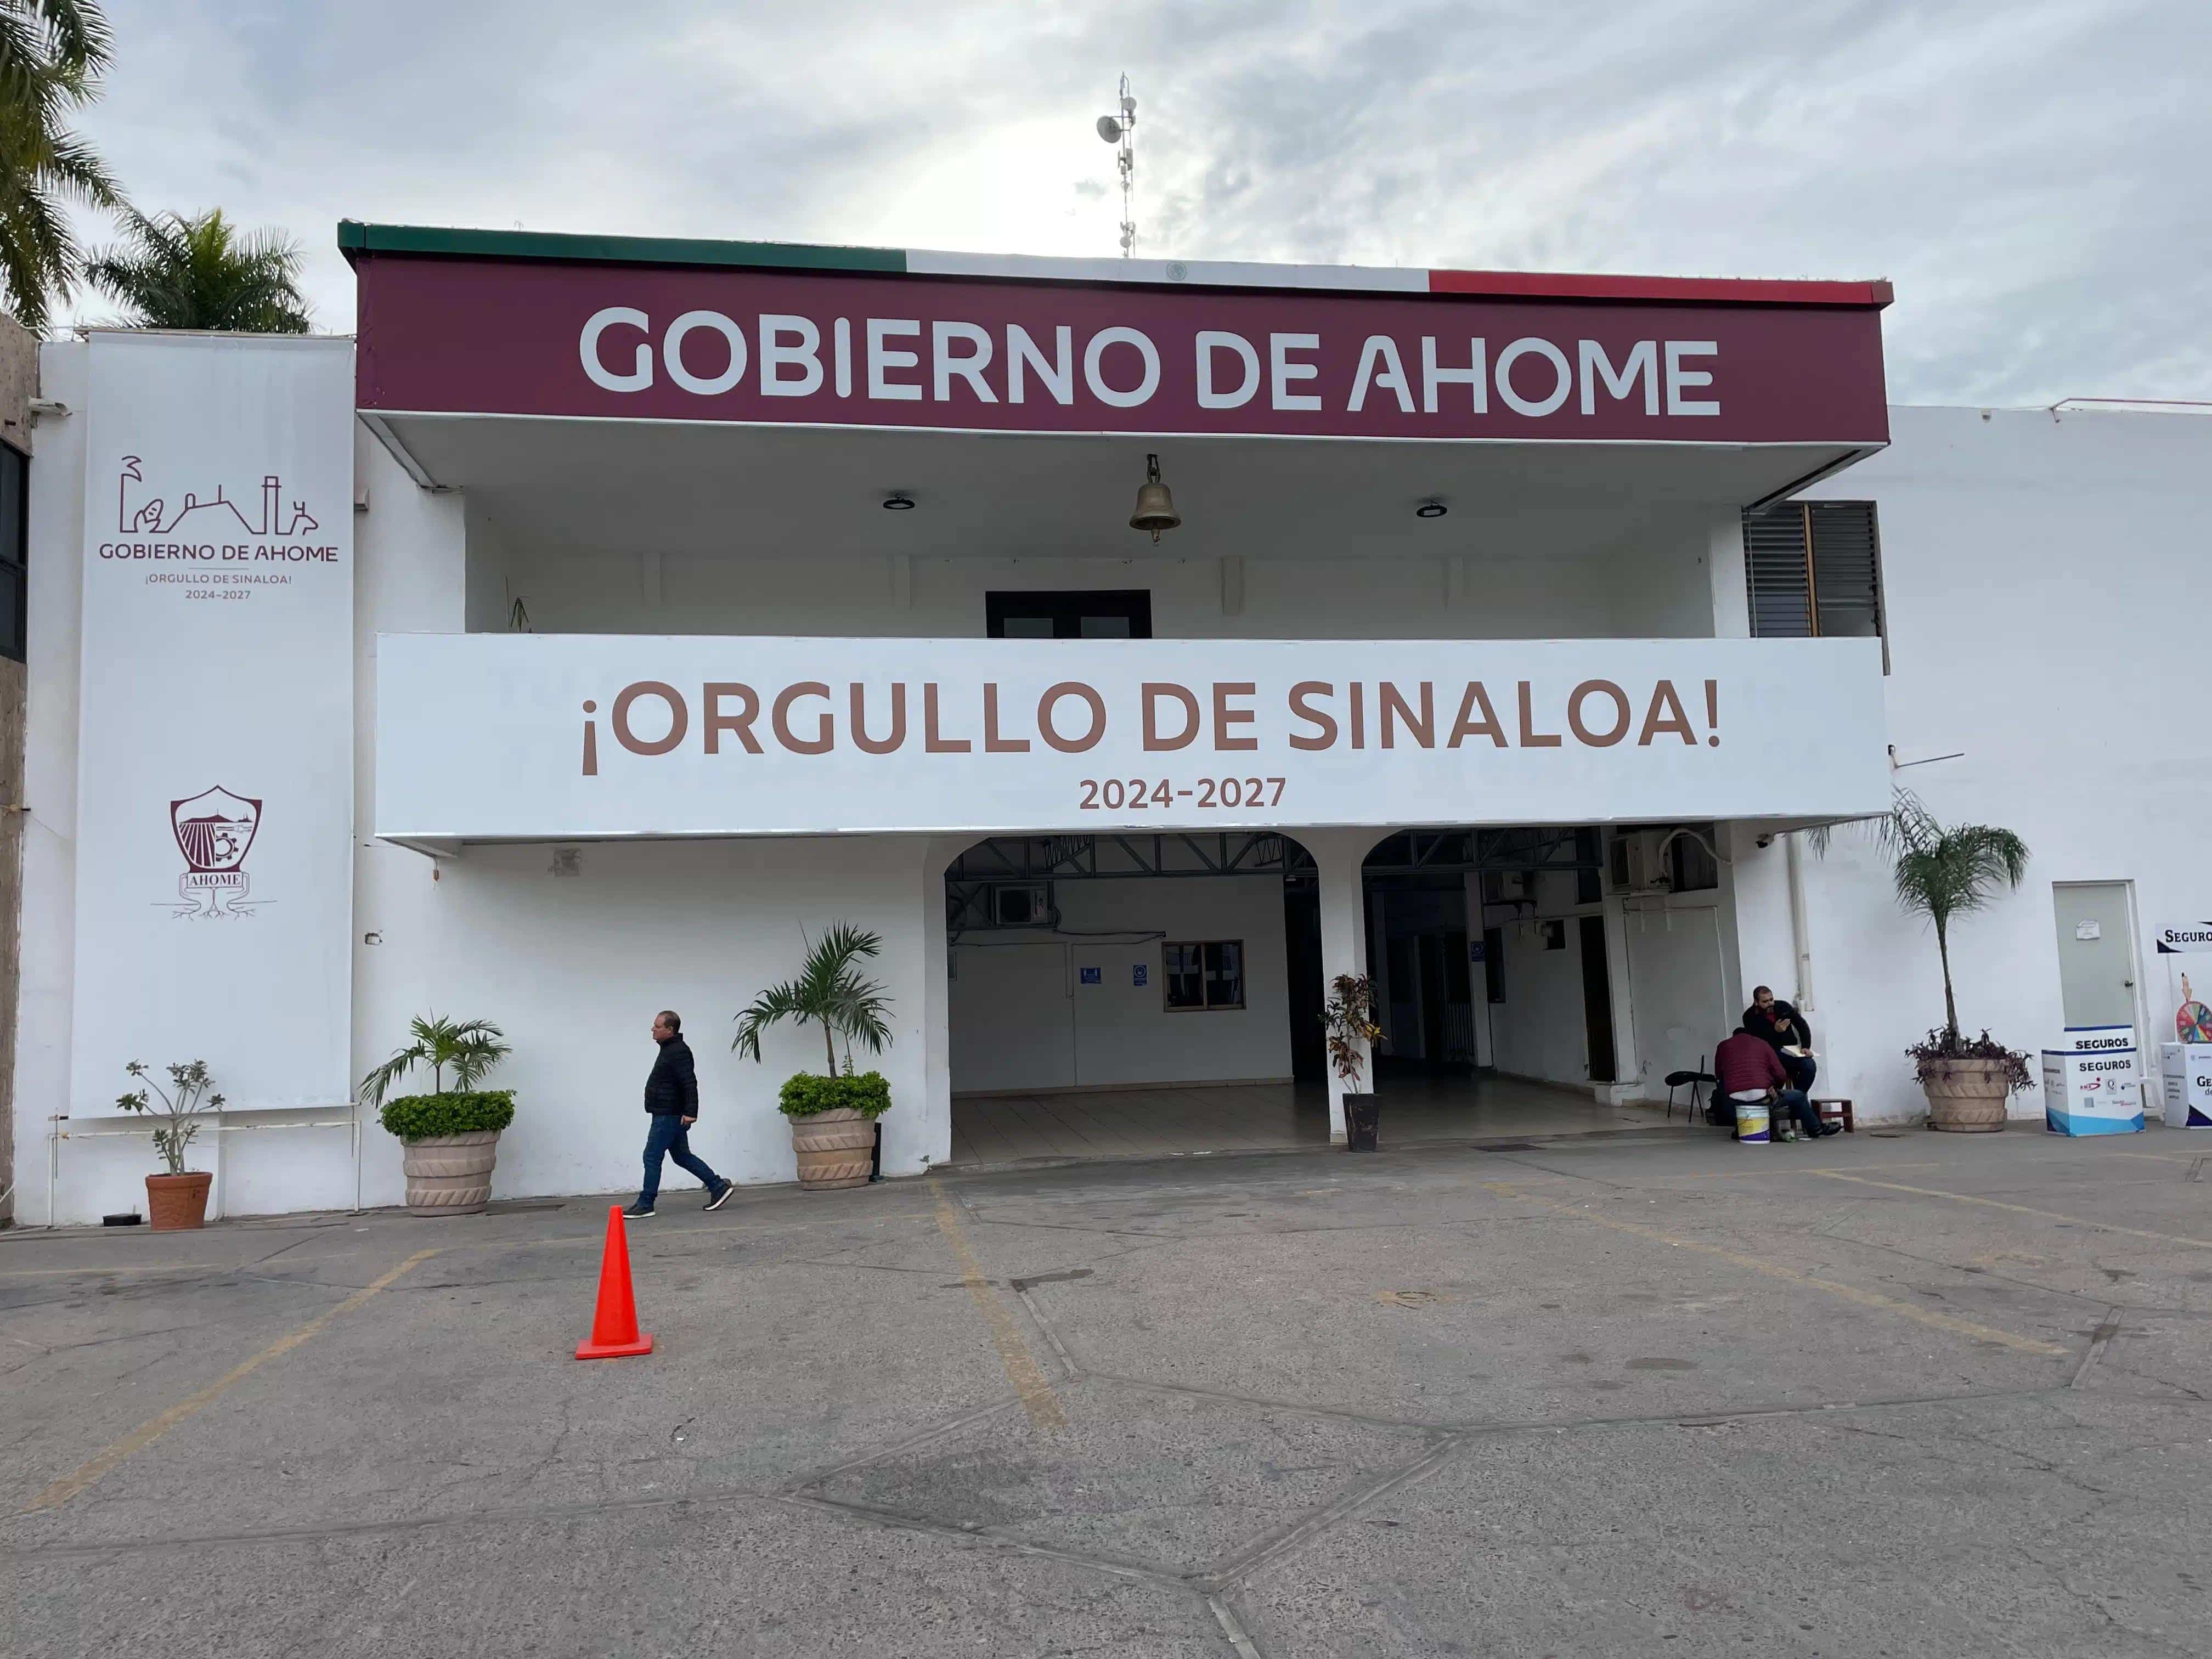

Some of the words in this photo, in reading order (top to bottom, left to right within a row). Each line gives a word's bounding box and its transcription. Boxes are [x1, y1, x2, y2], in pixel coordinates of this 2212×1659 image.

[579, 307, 1161, 408] GOBIERNO
[1195, 330, 1322, 411] DE
[1346, 335, 1720, 417] AHOME
[99, 543, 215, 560] GOBIERNO
[222, 545, 249, 560] DE
[254, 545, 338, 562] AHOME
[145, 573, 210, 585] ¡ORGULLO
[213, 574, 229, 584] DE
[232, 574, 292, 585] SINALOA!
[185, 590, 251, 600] 2024-2027
[582, 680, 1107, 776] ¡ORGULLO
[1141, 682, 1259, 752] DE
[1288, 679, 1720, 751] SINALOA!
[1080, 777, 1286, 810] 2024-2027
[190, 874, 240, 885] AHOME
[2165, 930, 2212, 943] SEGURO
[2075, 1038, 2129, 1049] SEGUROS
[2079, 1059, 2131, 1071] SEGUROS
[2197, 1076, 2212, 1087] GE
